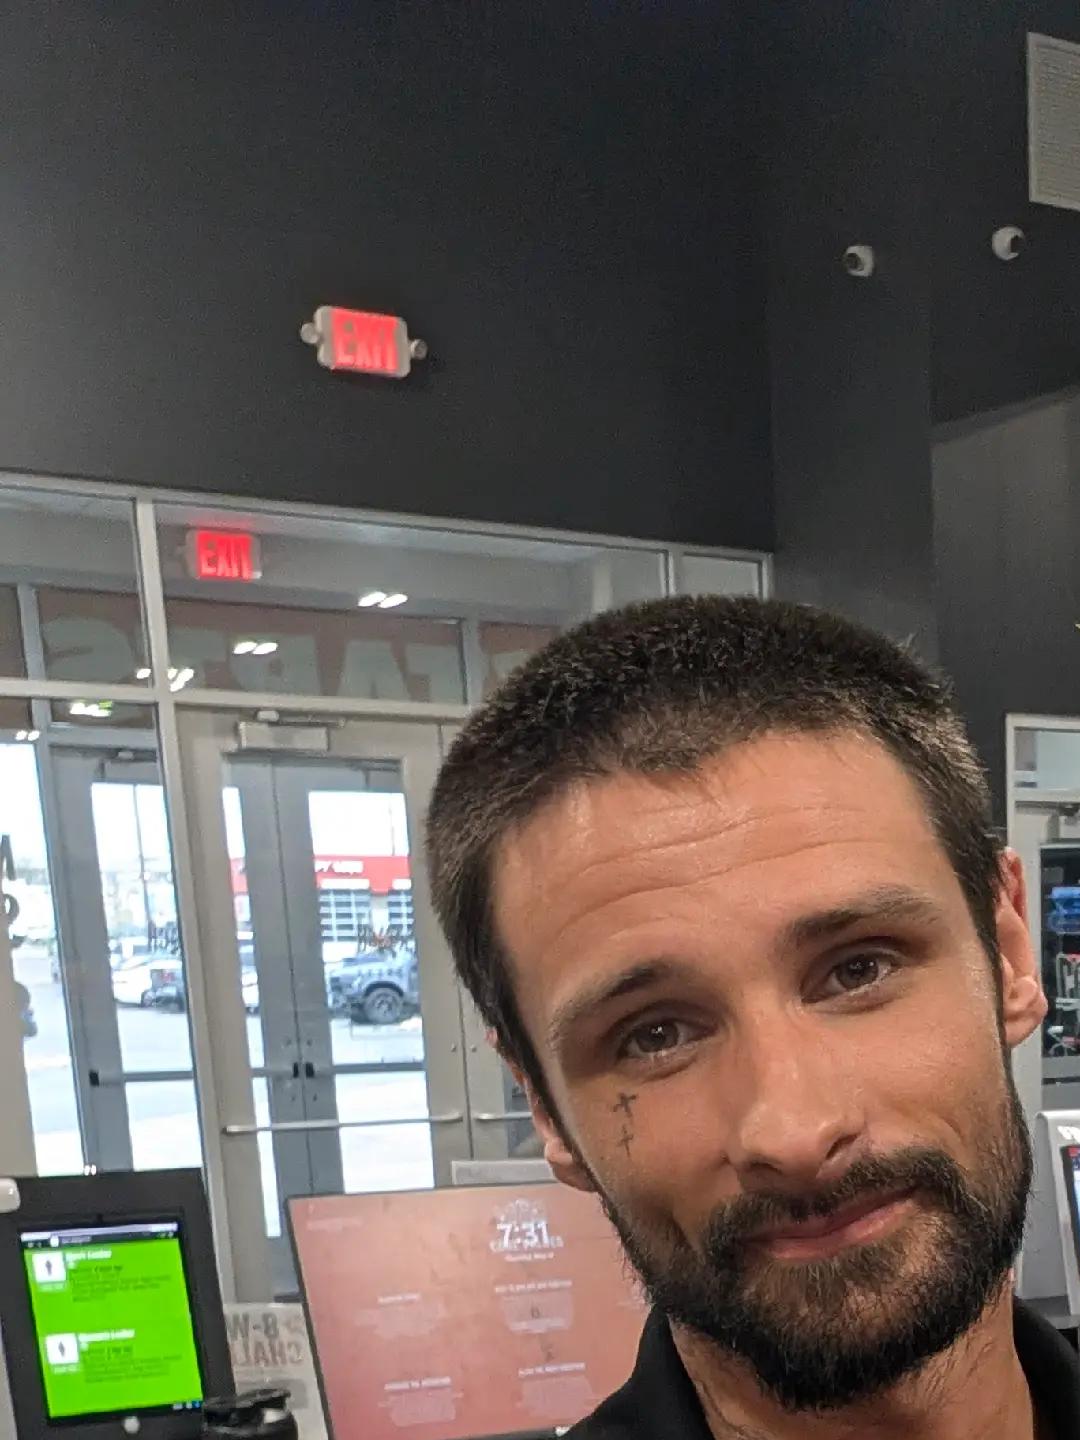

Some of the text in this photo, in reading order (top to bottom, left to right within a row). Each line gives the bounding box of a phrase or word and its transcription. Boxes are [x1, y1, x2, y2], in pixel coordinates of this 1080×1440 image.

[334, 313, 397, 370] EXIT
[199, 534, 252, 579] EXIT
[496, 1221, 550, 1249] 7:31
